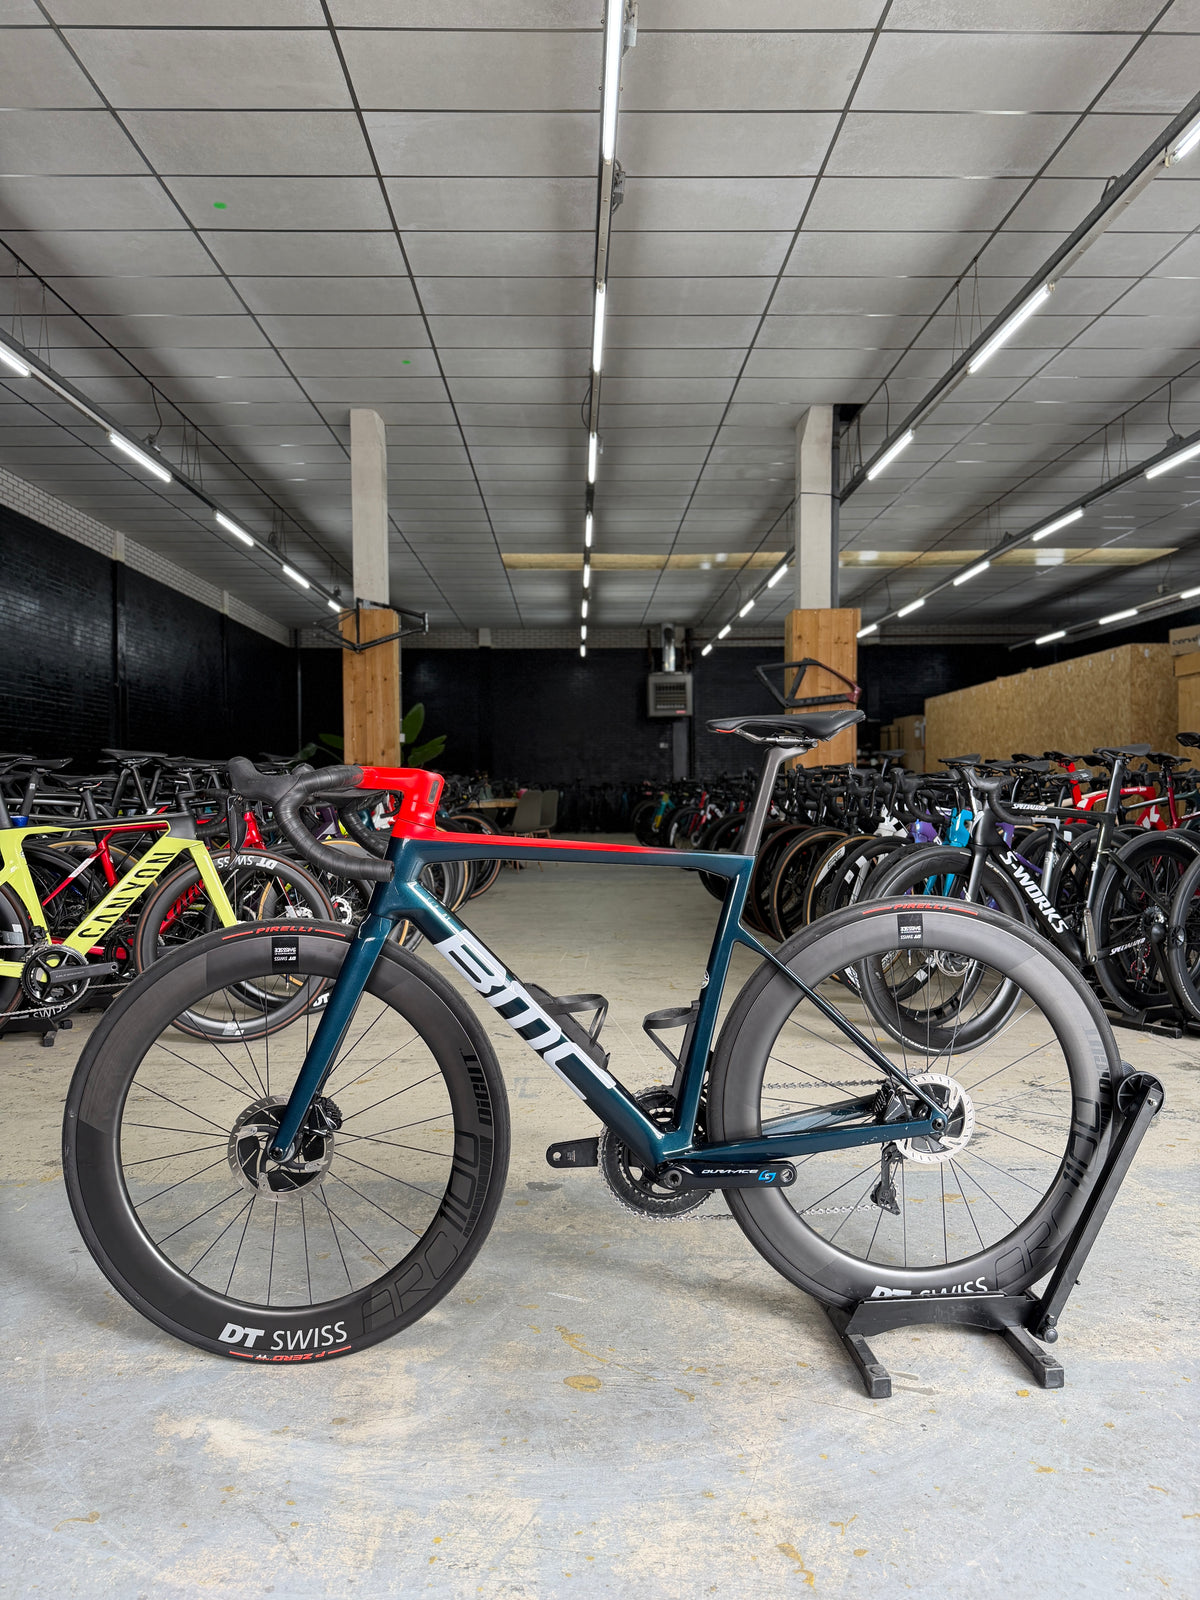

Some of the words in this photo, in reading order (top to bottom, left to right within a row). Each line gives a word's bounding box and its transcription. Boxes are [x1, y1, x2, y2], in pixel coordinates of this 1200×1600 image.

[1011, 803, 1048, 811] SPECIALIZED
[217, 855, 255, 869] SWSS
[78, 852, 175, 938] CANYON
[999, 849, 1069, 934] S-WORKS
[255, 926, 313, 935] PIRELLI
[433, 928, 616, 1101] BMC
[362, 1231, 459, 1334] ARC
[439, 1130, 479, 1235] 1100
[218, 1322, 264, 1348] DT
[271, 1321, 348, 1350] SWISS
[272, 1353, 313, 1361] ZERO
